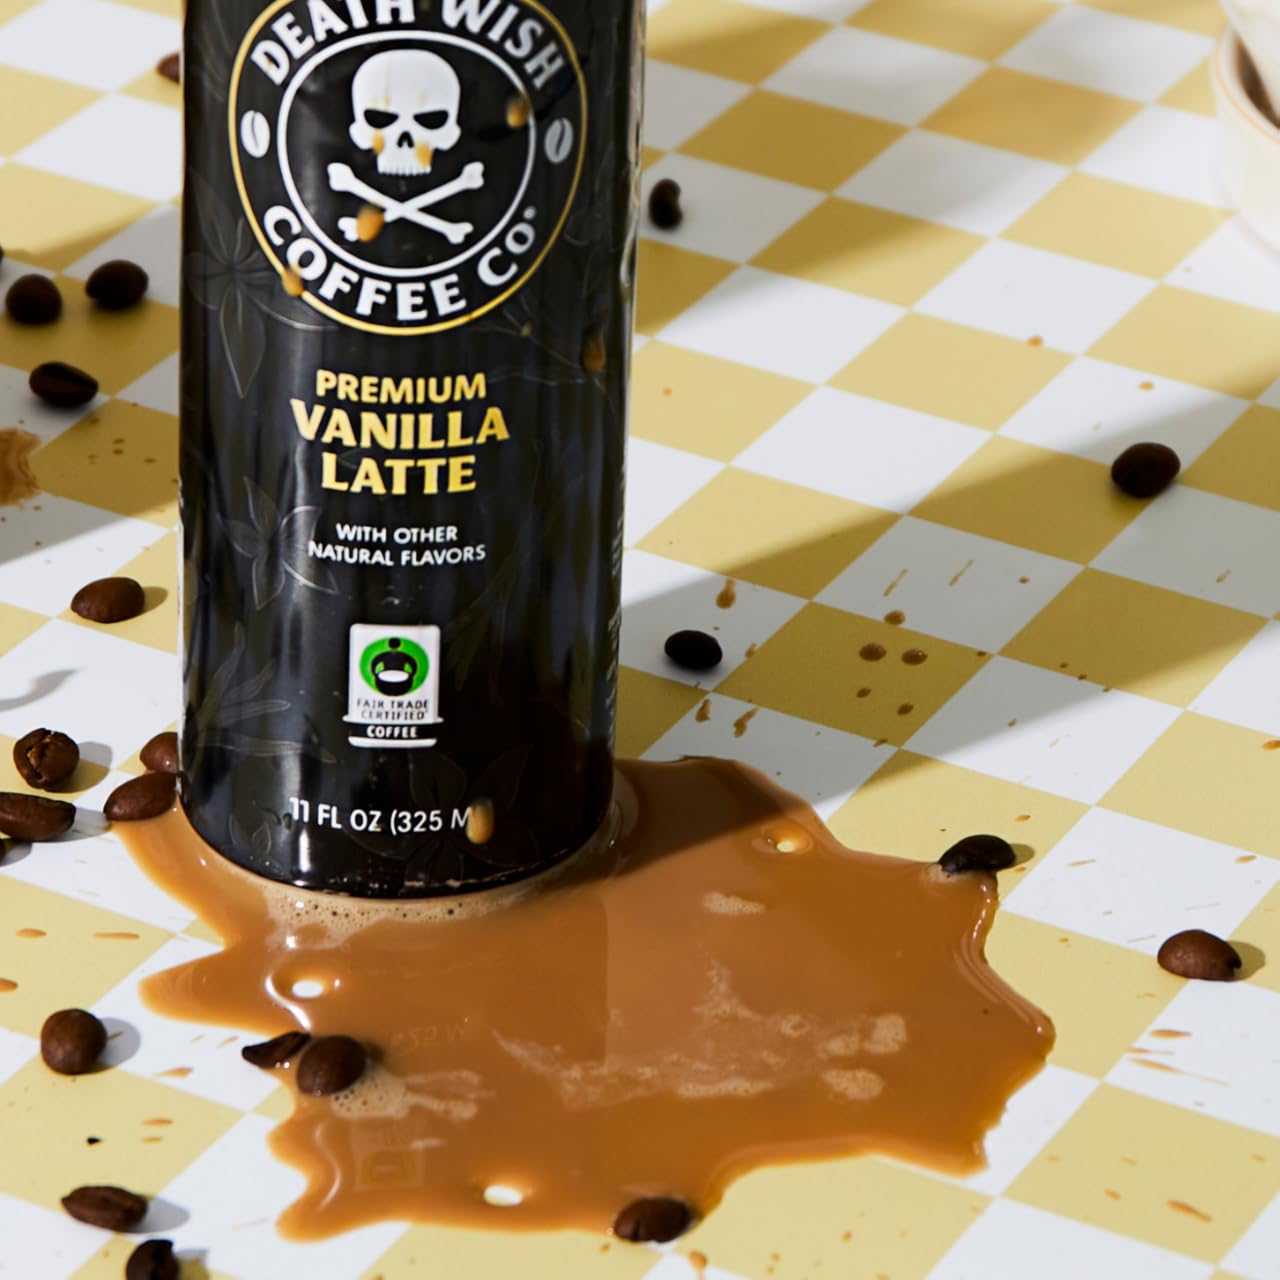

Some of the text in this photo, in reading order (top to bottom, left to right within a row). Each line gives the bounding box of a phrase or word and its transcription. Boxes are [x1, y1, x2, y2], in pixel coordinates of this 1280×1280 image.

[263, 205, 467, 321] COFFEE
[316, 369, 486, 404] PREMIUM
[290, 398, 510, 450] VANILLA
[321, 451, 476, 495] LATTE
[336, 522, 458, 545] WITH OTHER
[307, 539, 487, 567] NATURAL FLAVORS
[357, 699, 429, 709] FAIR TRADE
[366, 725, 418, 738] COFFEE
[289, 796, 310, 823] 11
[317, 803, 343, 829] FL
[349, 809, 383, 832] OZ
[389, 808, 444, 837] (325
